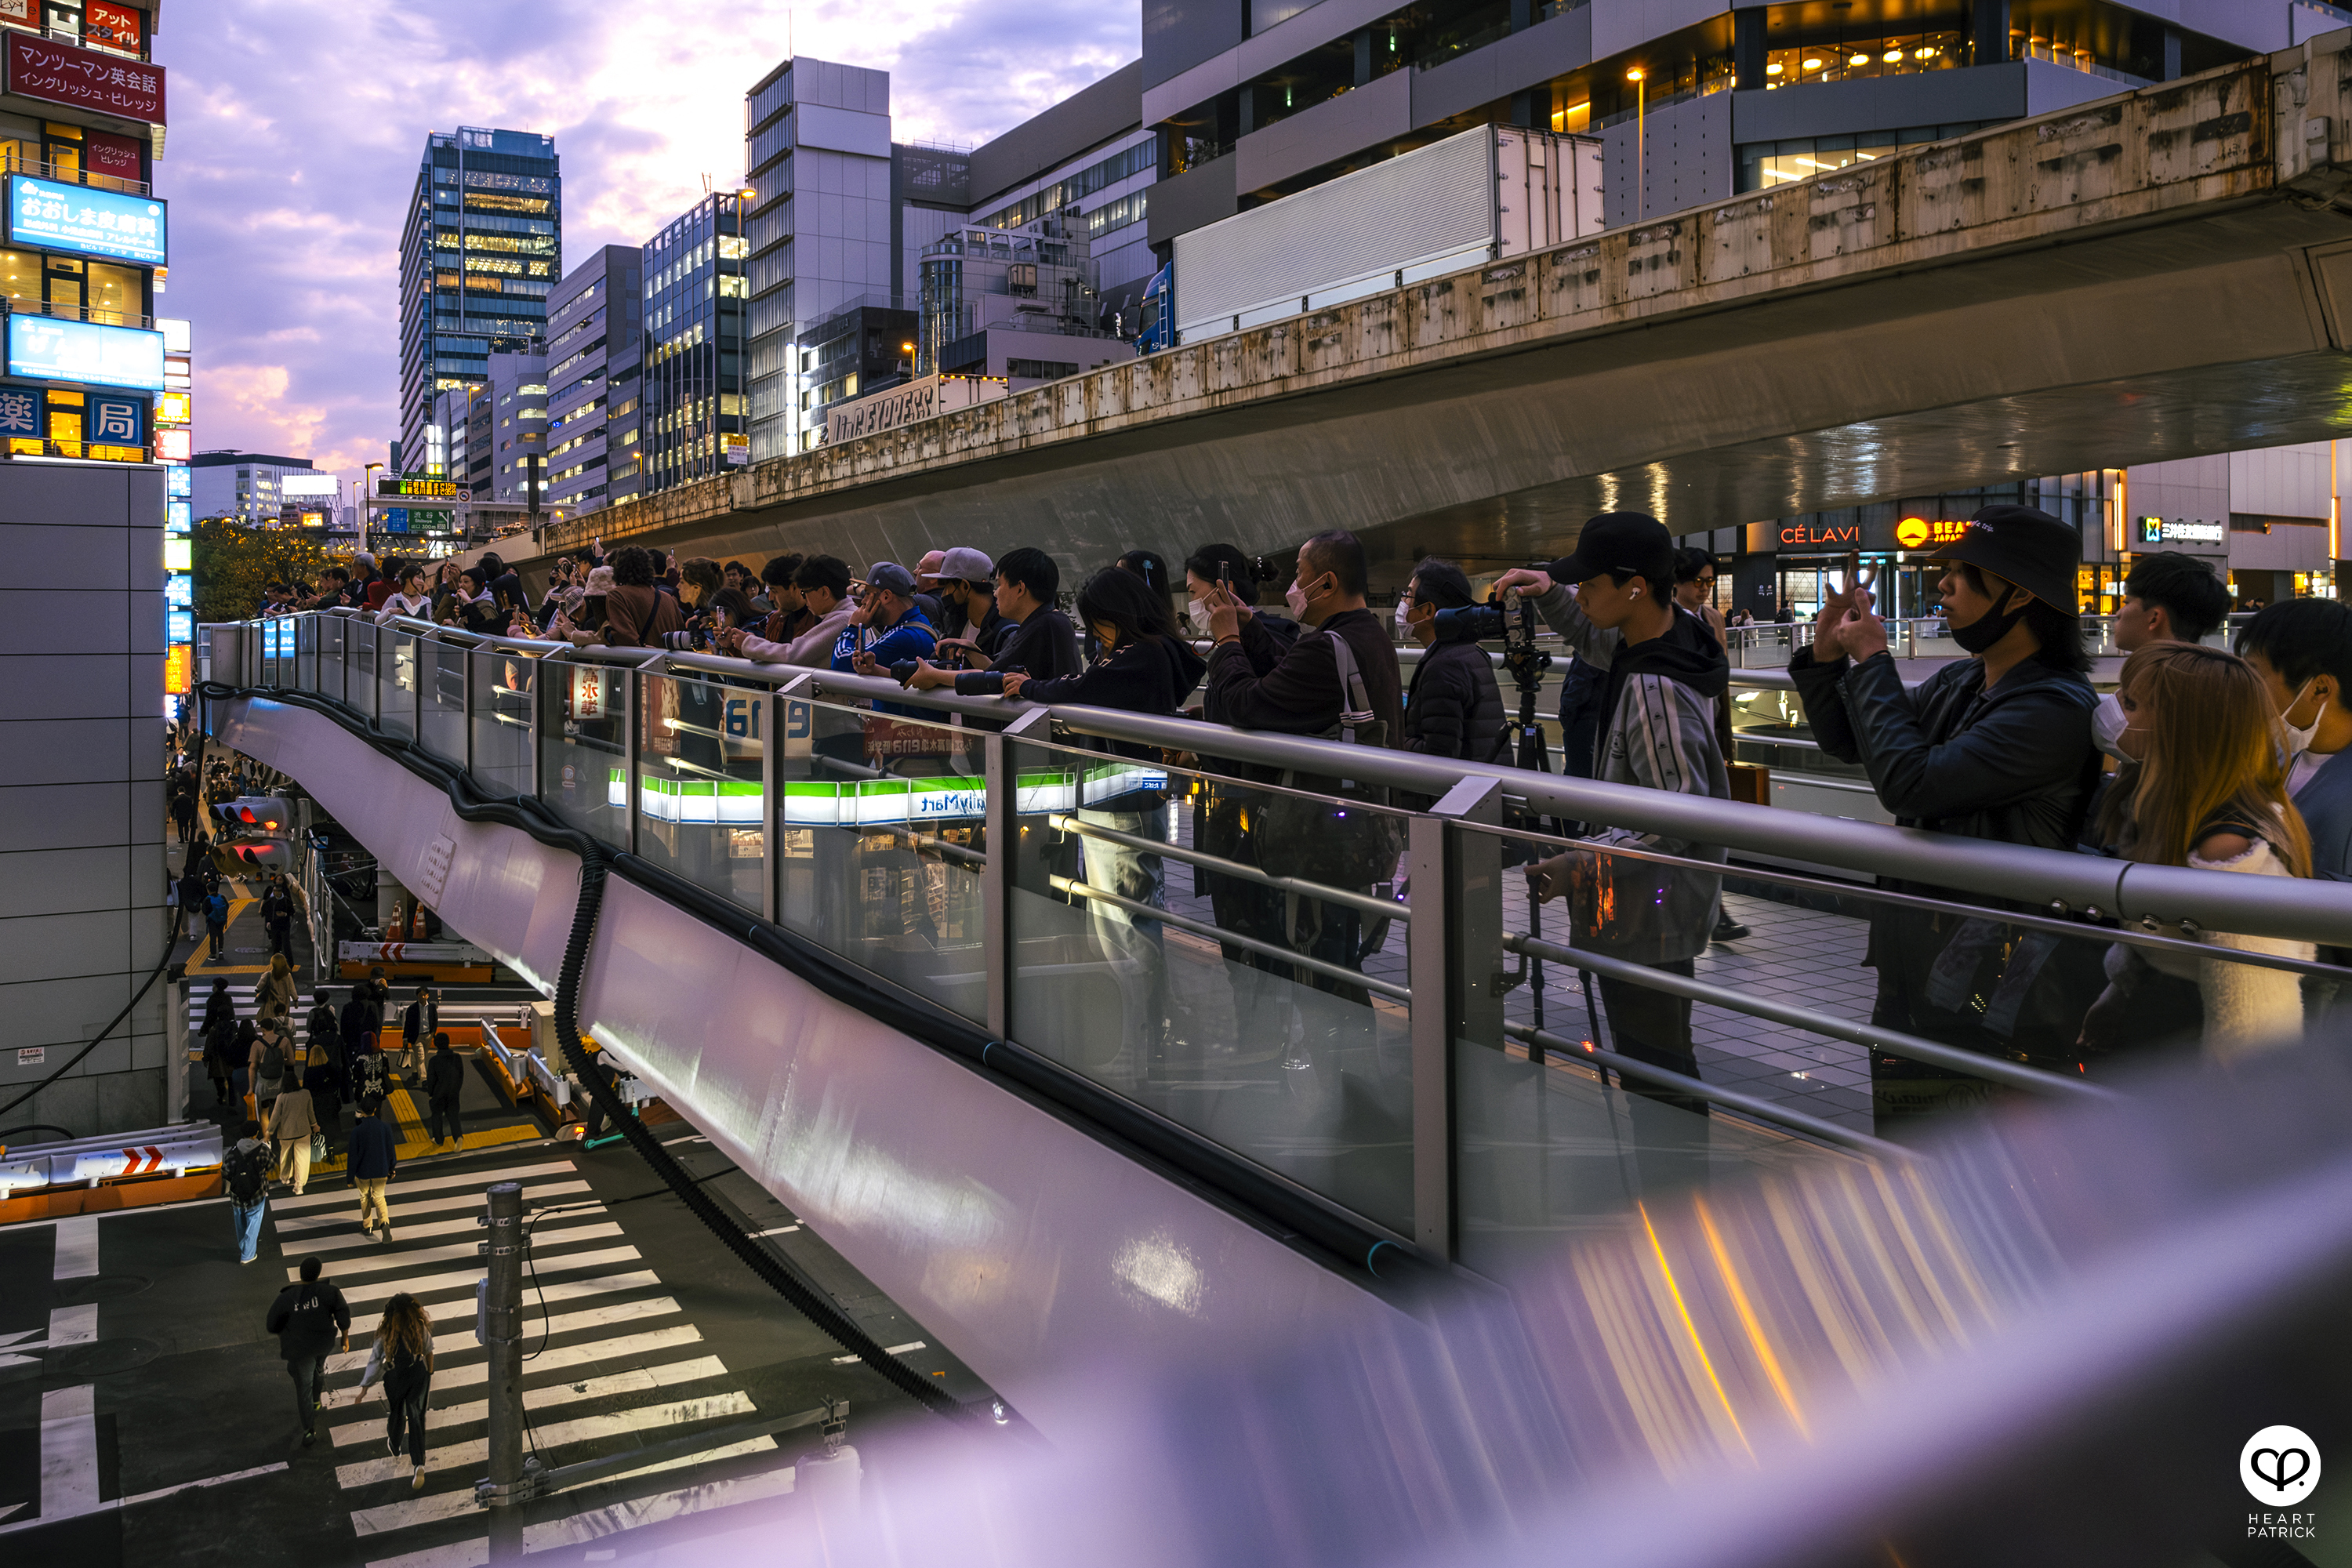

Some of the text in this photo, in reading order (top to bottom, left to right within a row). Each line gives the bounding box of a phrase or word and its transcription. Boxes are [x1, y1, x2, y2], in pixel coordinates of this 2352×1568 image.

[94, 8, 132, 28] アット
[19, 45, 157, 94] マンツーマン英会話
[20, 72, 157, 112] イングリッシュ・ビレッジ
[92, 143, 136, 159] イングリッシュ
[21, 198, 158, 237] おおしま皮膚科
[0, 394, 134, 439] 薬 局
[866, 385, 933, 433] EXPRESS
